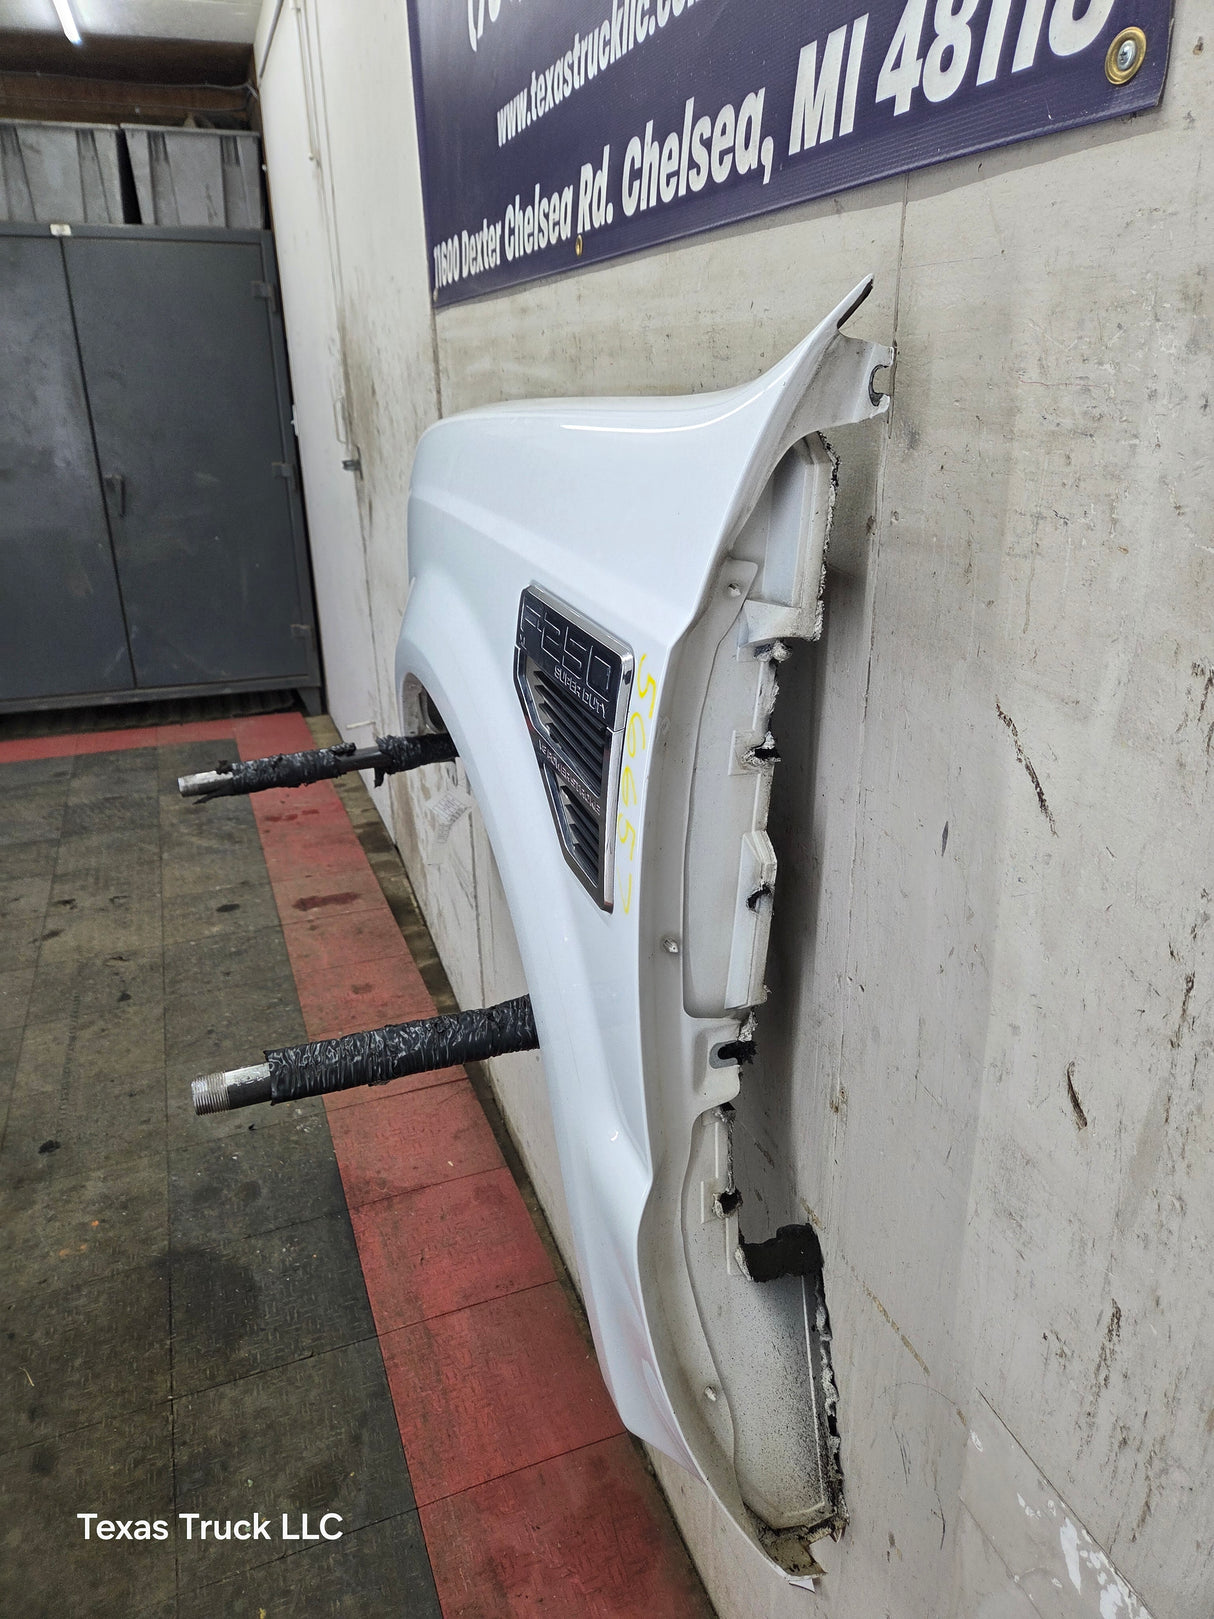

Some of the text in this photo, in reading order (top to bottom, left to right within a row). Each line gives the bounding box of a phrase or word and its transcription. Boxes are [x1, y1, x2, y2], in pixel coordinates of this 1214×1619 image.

[433, 234, 460, 288] 11600
[461, 218, 502, 279] Dexter
[504, 183, 574, 262] Chelsea
[577, 145, 614, 234] Rd.
[621, 86, 774, 217] Chelsea,
[788, 13, 869, 156] MI
[553, 665, 609, 720] SUPER DUTY
